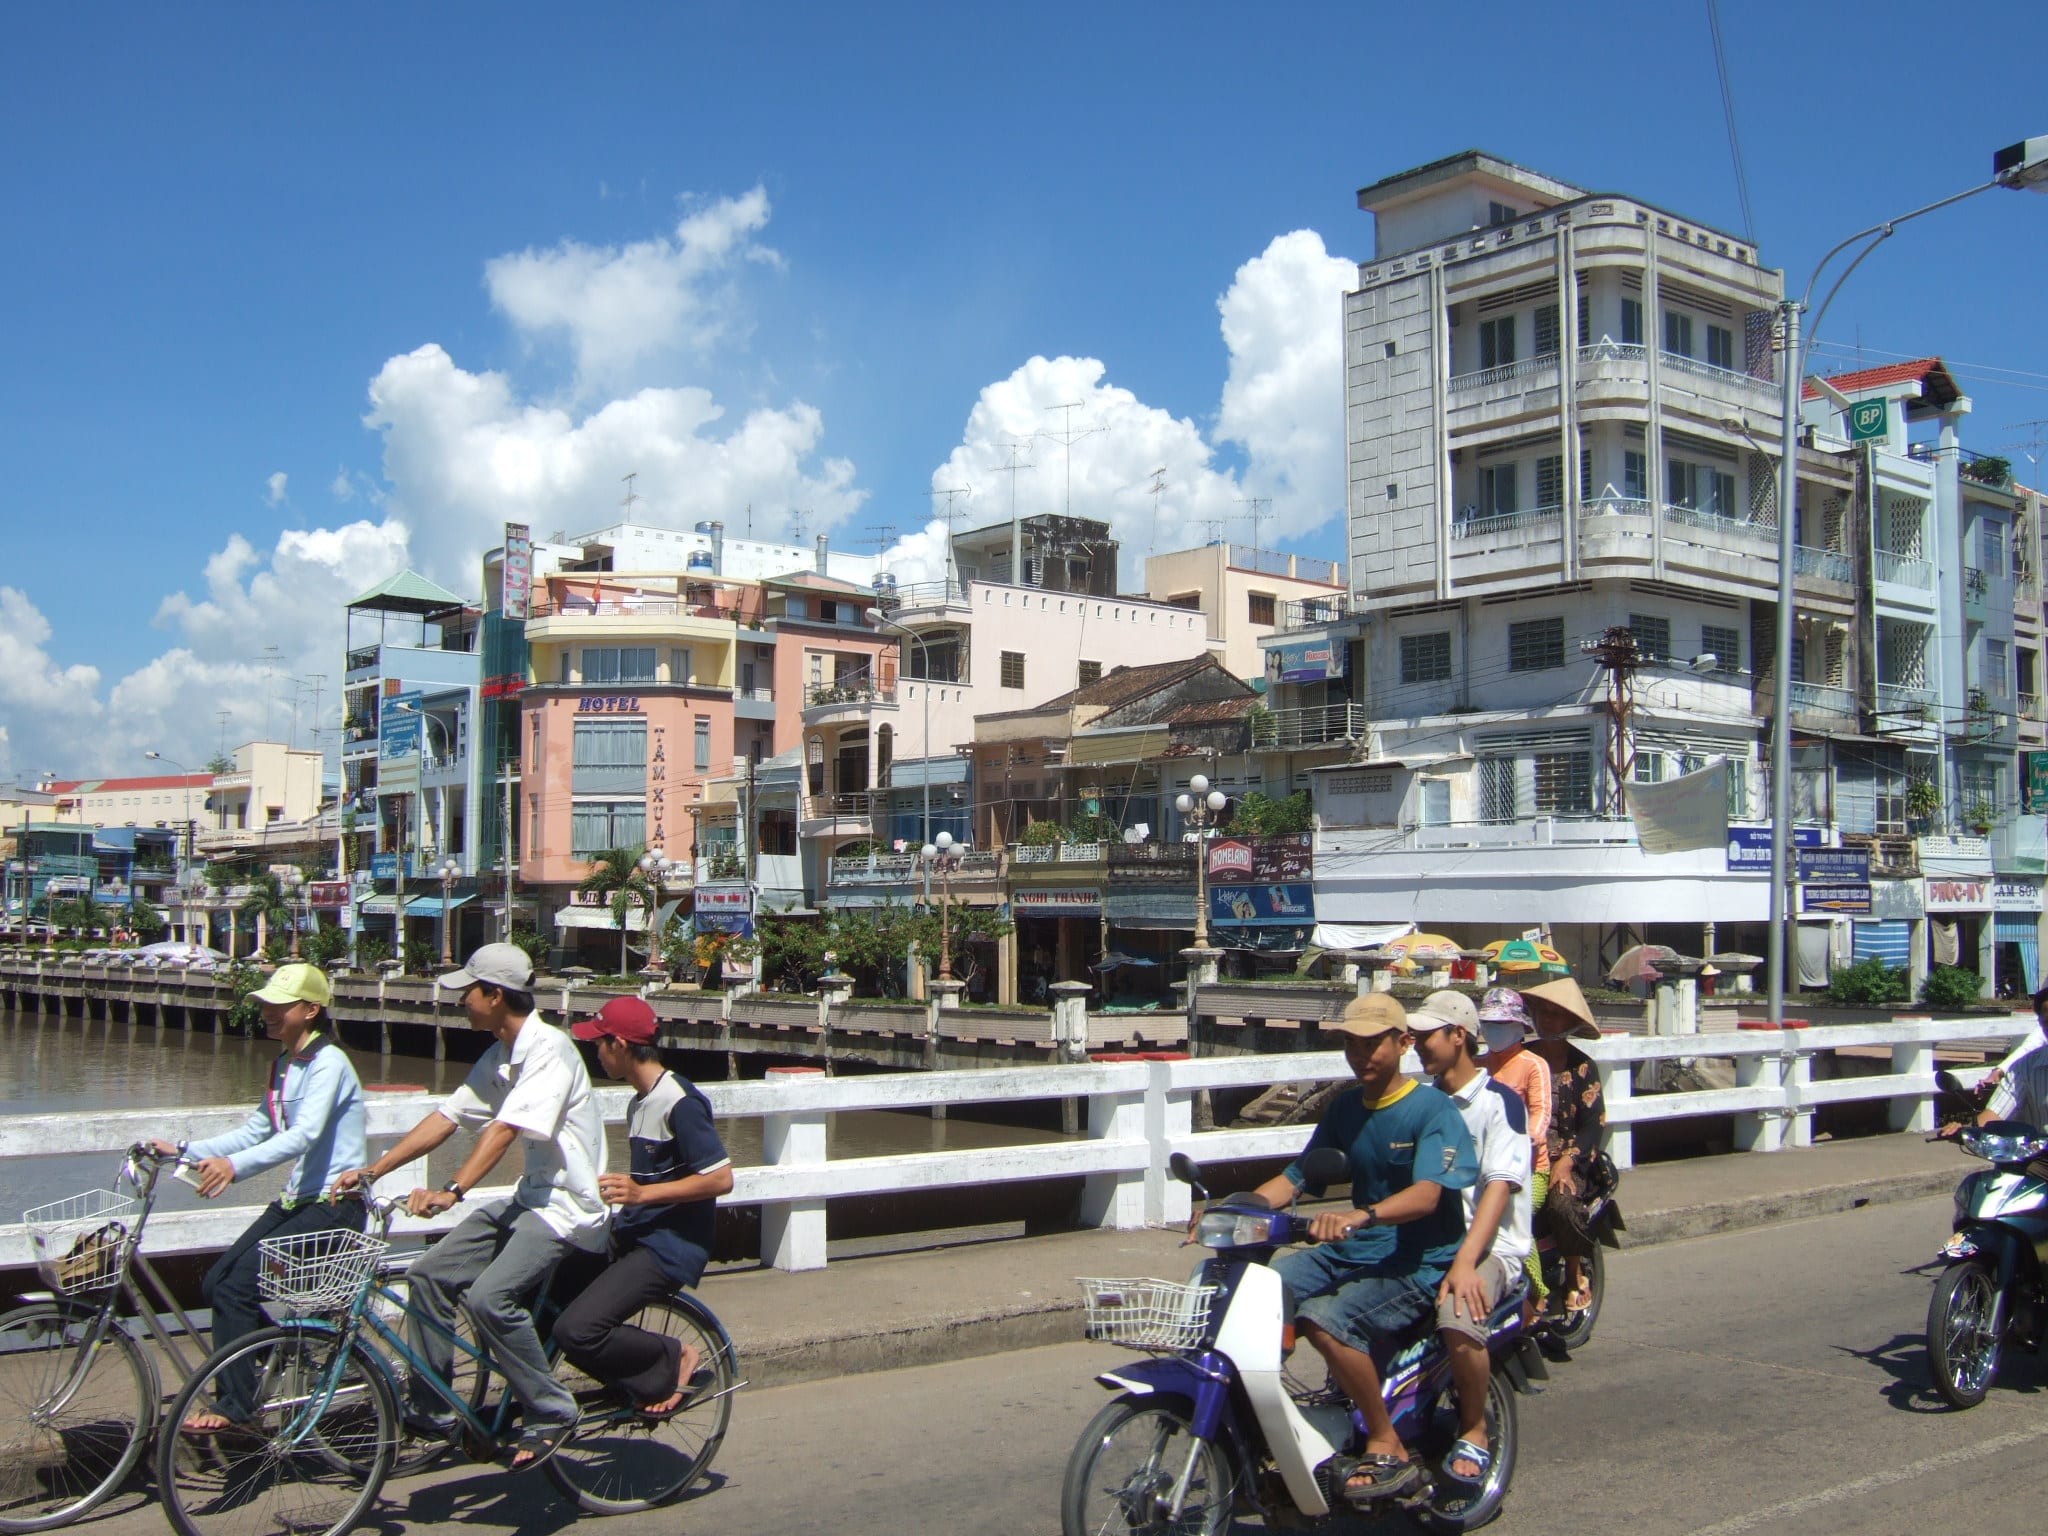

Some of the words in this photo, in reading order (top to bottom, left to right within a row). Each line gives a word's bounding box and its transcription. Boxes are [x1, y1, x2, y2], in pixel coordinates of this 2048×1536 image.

[1860, 408, 1880, 425] BP
[508, 539, 527, 618] HOTEL
[578, 697, 641, 712] HOTEL
[1212, 847, 1249, 869] HOMELAND
[1022, 892, 1047, 903] NGHI
